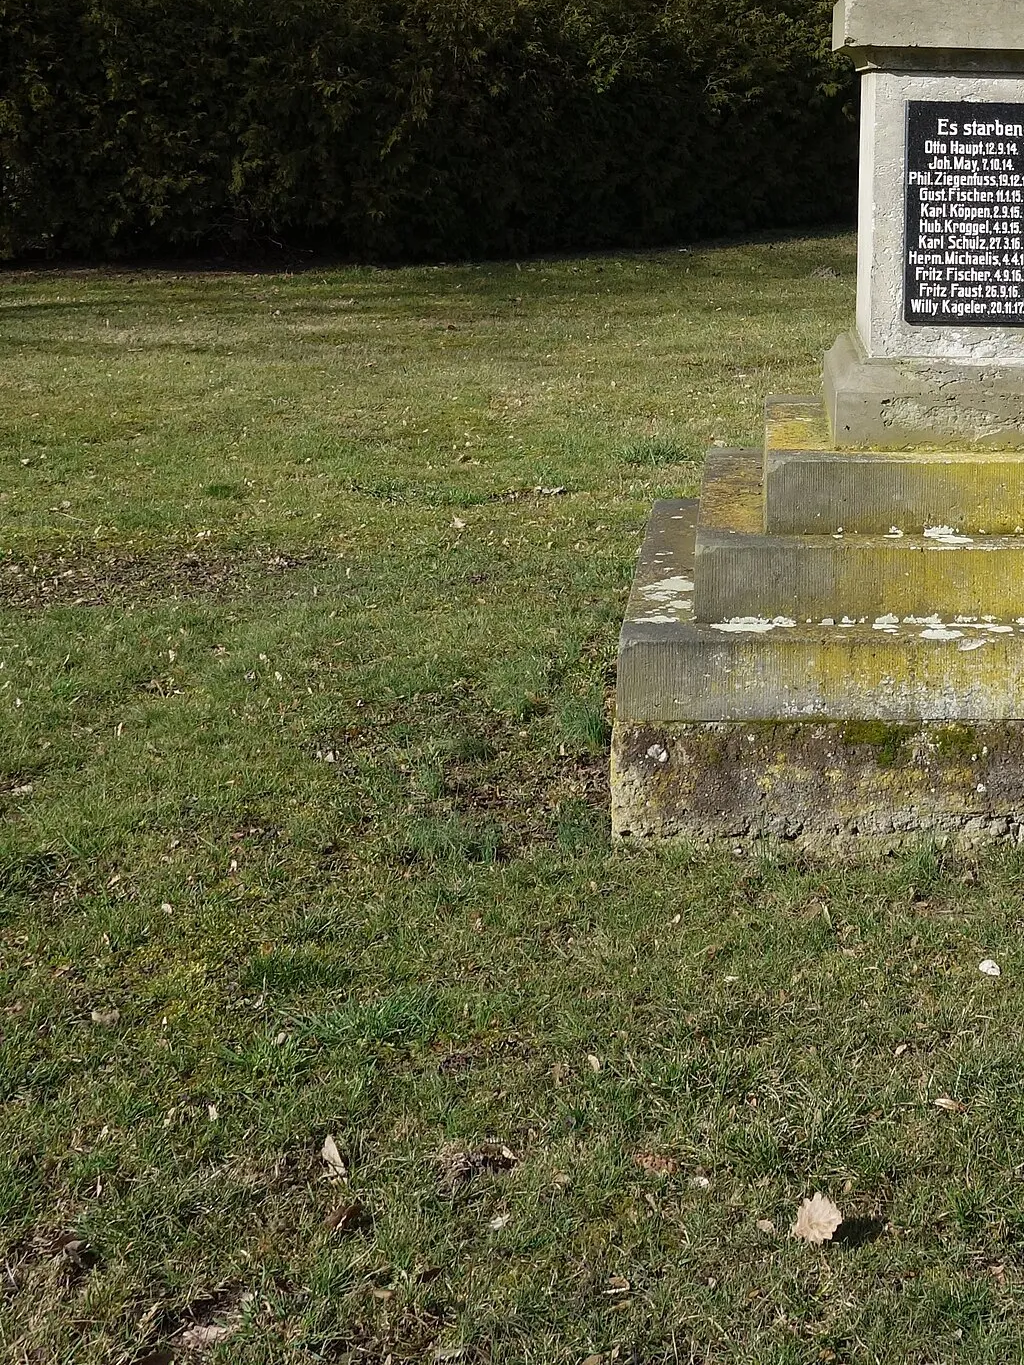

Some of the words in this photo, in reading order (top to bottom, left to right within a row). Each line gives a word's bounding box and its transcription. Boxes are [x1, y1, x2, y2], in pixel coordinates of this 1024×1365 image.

[938, 119, 958, 135] Es
[964, 120, 1023, 136] starben
[925, 140, 946, 154] Otto
[916, 267, 942, 280] Fritz
[920, 283, 947, 297] Fritz
[911, 299, 938, 316] Willy
